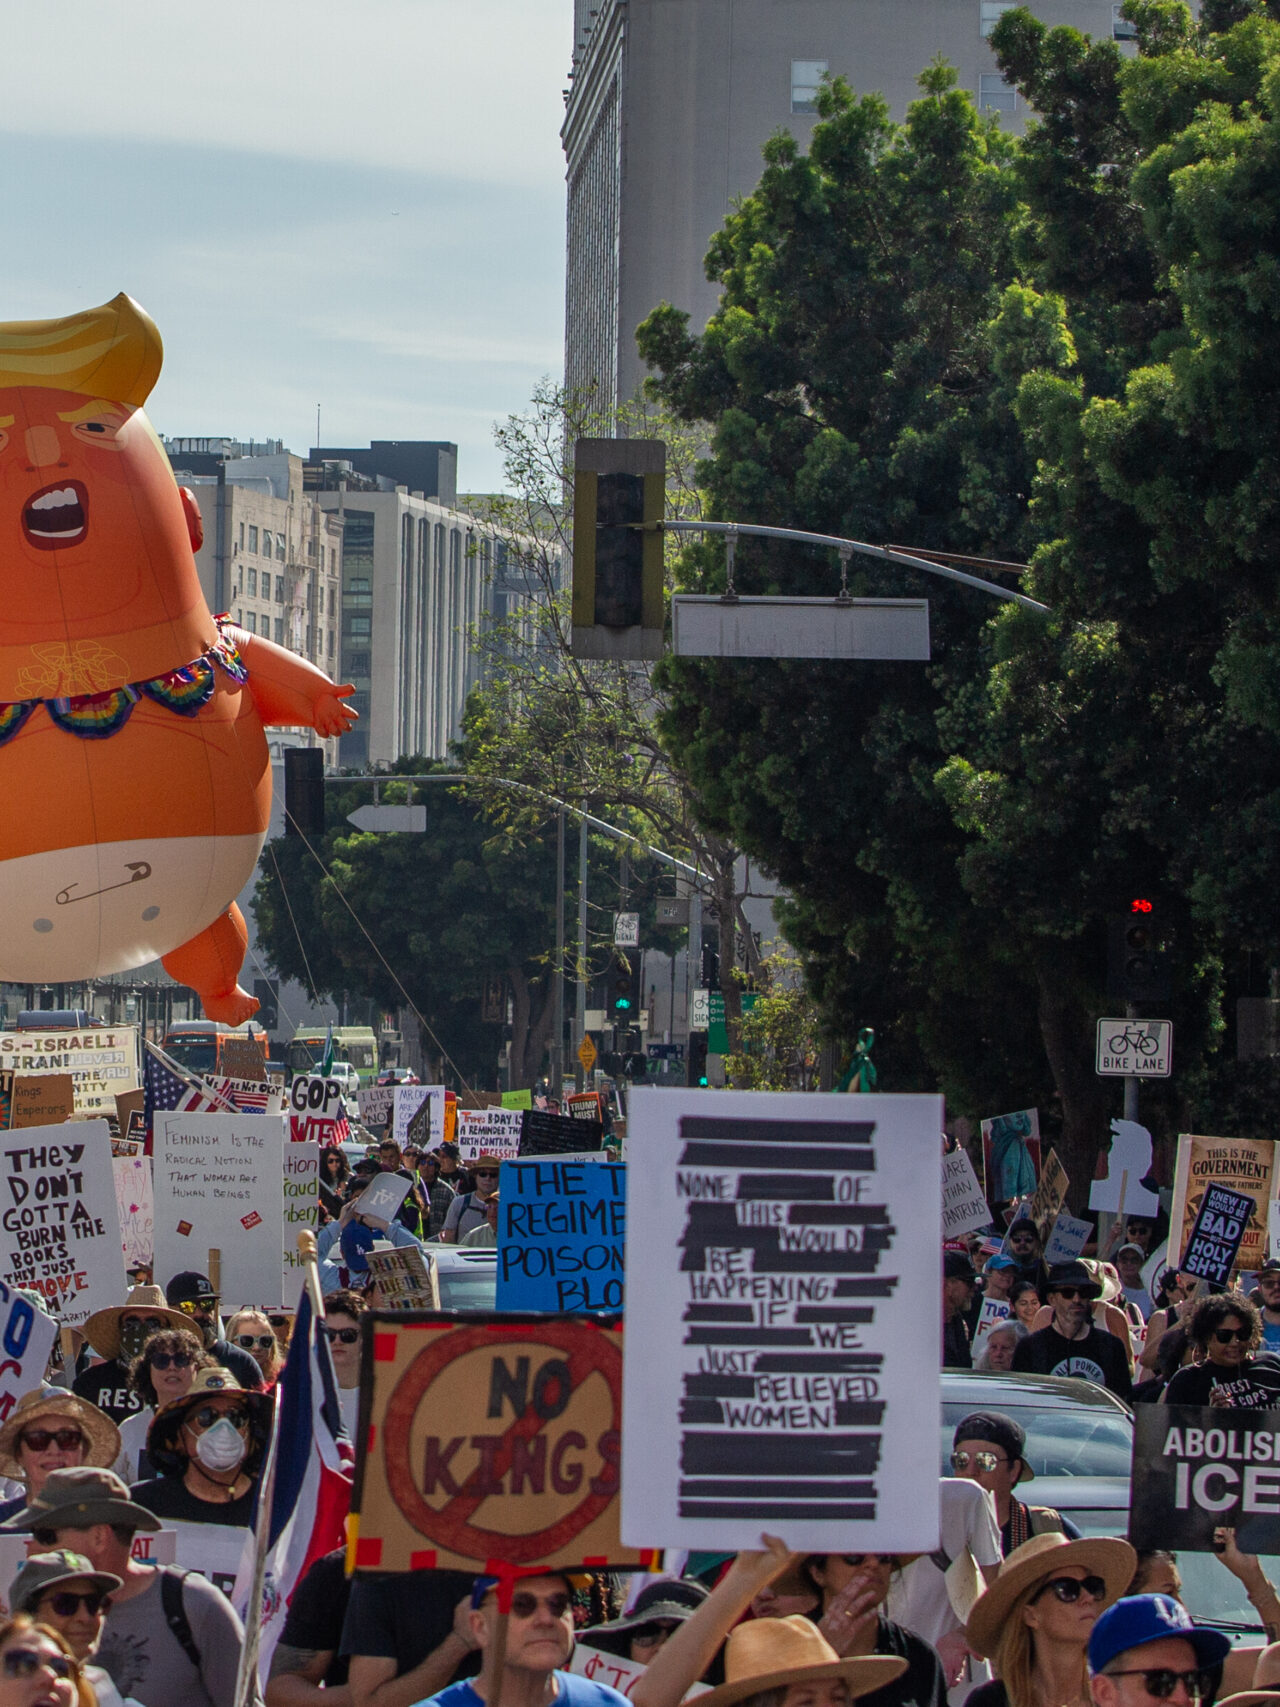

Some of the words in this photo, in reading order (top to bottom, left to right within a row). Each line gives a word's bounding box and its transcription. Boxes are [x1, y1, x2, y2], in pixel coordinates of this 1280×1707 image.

[615, 933, 637, 942] SIGNAL
[12, 1054, 70, 1070] IRAN!
[1103, 1056, 1129, 1068] BIKE
[1135, 1058, 1164, 1070] LANE
[291, 1076, 341, 1113] GOP
[570, 1101, 598, 1112] TRUMP
[573, 1109, 597, 1120] MUST
[460, 1126, 466, 1136] A
[469, 1125, 506, 1136] REMINDER
[480, 1136, 513, 1148] CONTROL
[470, 1150, 478, 1159] A
[1206, 1147, 1228, 1159] THIS
[1230, 1147, 1238, 1158] IS
[1241, 1150, 1259, 1160] THE
[203, 1172, 236, 1183] WOMEN
[508, 1163, 587, 1196] THE
[1192, 1159, 1270, 1179] GOVERNMENT
[172, 1186, 206, 1198] HUMAN
[213, 1187, 251, 1200] BEINGS
[676, 1171, 732, 1200] NONE
[838, 1175, 872, 1202] OF
[1237, 1180, 1263, 1190] FATHERS
[1207, 1200, 1235, 1215] WOULD
[1235, 1208, 1247, 1220] BE
[1209, 1189, 1239, 1207] KNEW
[1239, 1199, 1249, 1210] IT
[2, 1199, 91, 1232] GOTTA
[506, 1199, 626, 1238] REGIME
[736, 1201, 783, 1226] THIS
[1199, 1210, 1241, 1241] BAD
[17, 1223, 67, 1251] BURN
[72, 1218, 106, 1240] THE
[779, 1225, 861, 1252] WOULD
[10, 1242, 69, 1270] BOOKS
[706, 1247, 746, 1275] BE
[1191, 1238, 1233, 1264] HOLY
[4, 1266, 37, 1285] THEY
[41, 1257, 76, 1276] JUST
[689, 1271, 834, 1301] HAPPENING
[759, 1300, 790, 1327] IF
[815, 1324, 863, 1348] WE
[699, 1345, 756, 1374] JUST
[1074, 1359, 1101, 1379] POWER
[487, 1354, 571, 1421] NO
[755, 1375, 880, 1403] BELIEVED
[1238, 1390, 1269, 1406] COPS
[723, 1404, 833, 1429] WOMEN
[423, 1430, 621, 1498] KINGS
[1174, 1462, 1280, 1513] ICE
